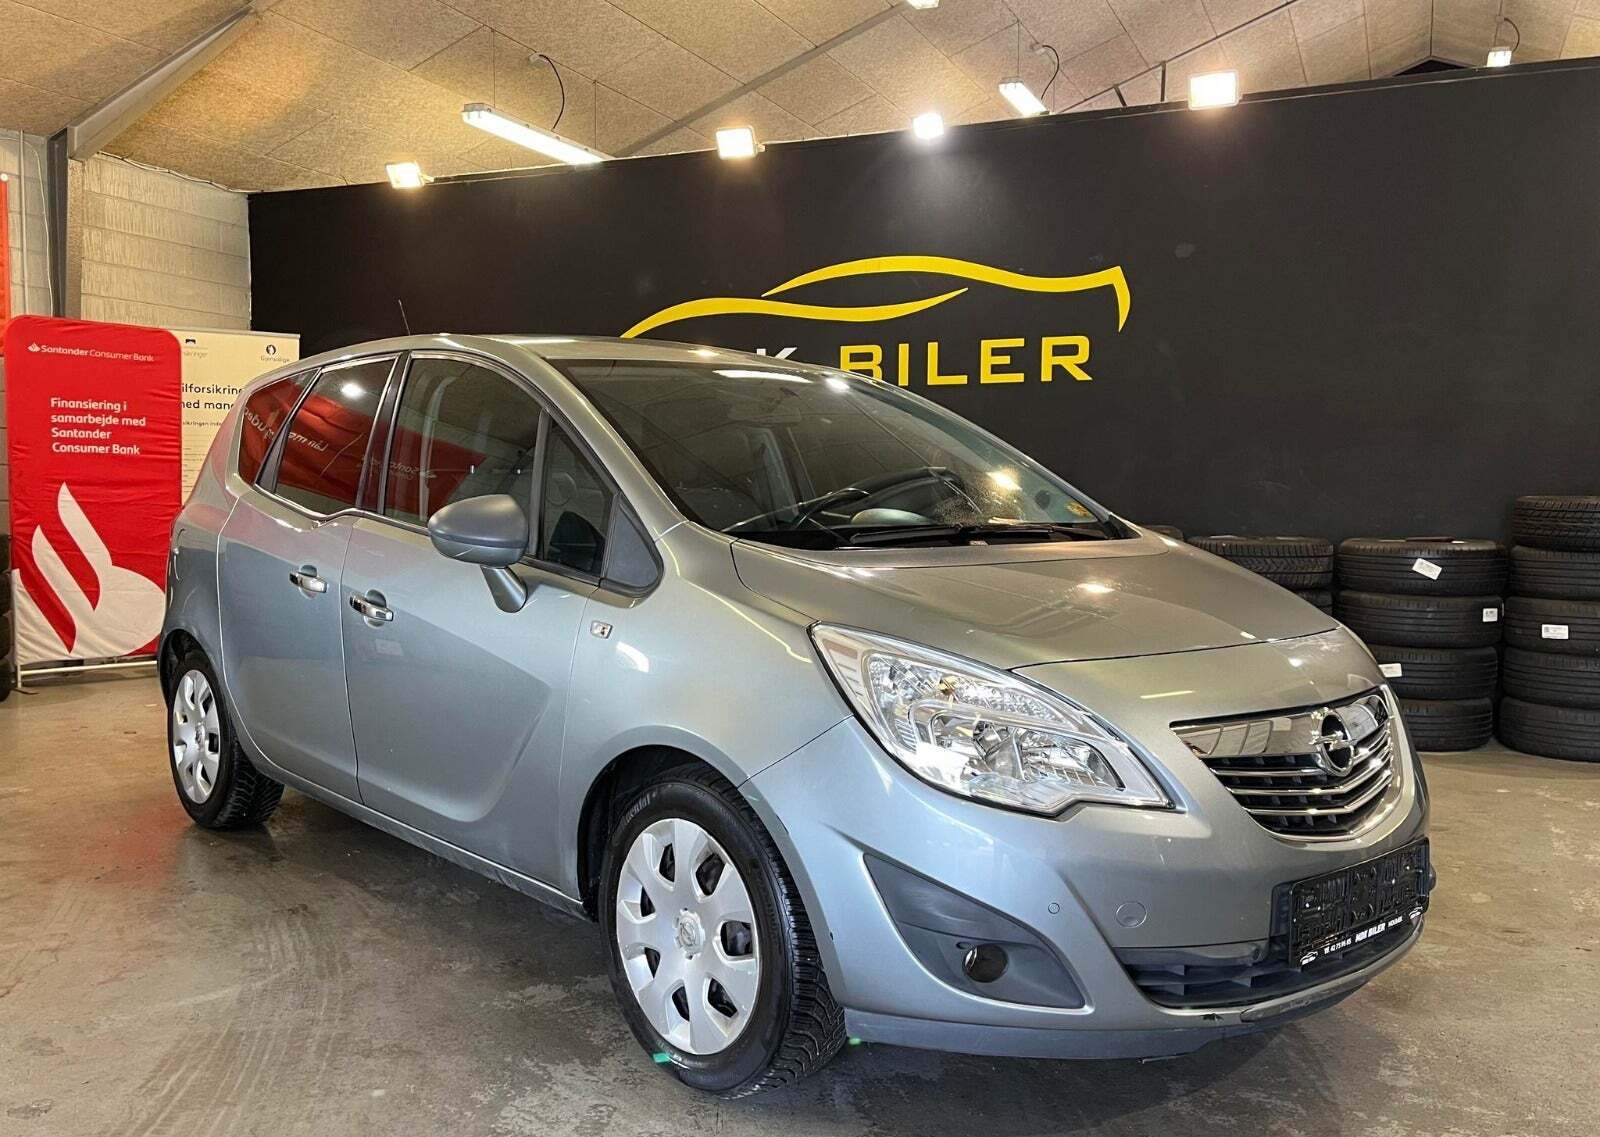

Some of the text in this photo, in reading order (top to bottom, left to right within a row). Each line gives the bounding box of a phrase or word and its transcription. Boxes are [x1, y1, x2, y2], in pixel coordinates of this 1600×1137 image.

[41, 344, 154, 362] Santander Consumer Bank
[840, 335, 1092, 386] BILER
[50, 397, 127, 412] Finansiering i
[51, 412, 146, 427] samarbejde med
[52, 427, 111, 439] Santander
[52, 441, 140, 455] Consumer Bank
